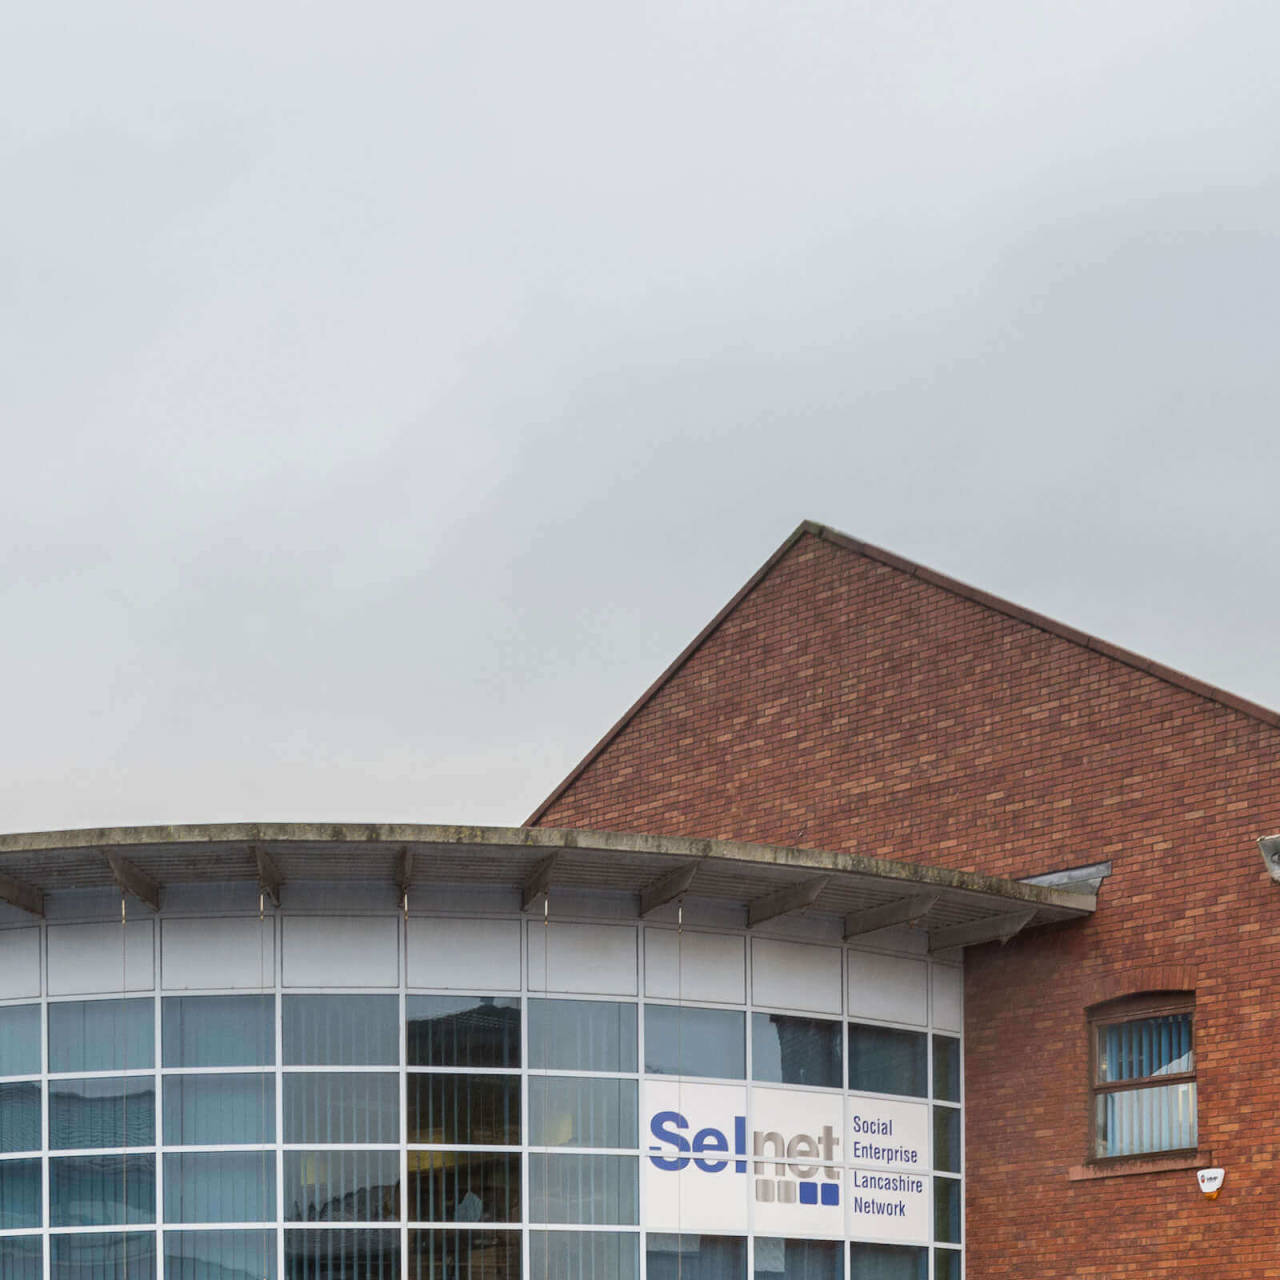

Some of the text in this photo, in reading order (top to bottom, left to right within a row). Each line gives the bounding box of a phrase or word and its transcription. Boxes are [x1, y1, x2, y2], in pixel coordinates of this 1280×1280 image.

[853, 1116, 893, 1136] Social
[853, 1141, 918, 1164] Enterprise
[854, 1171, 923, 1194] Lancashire
[854, 1197, 906, 1217] Network
